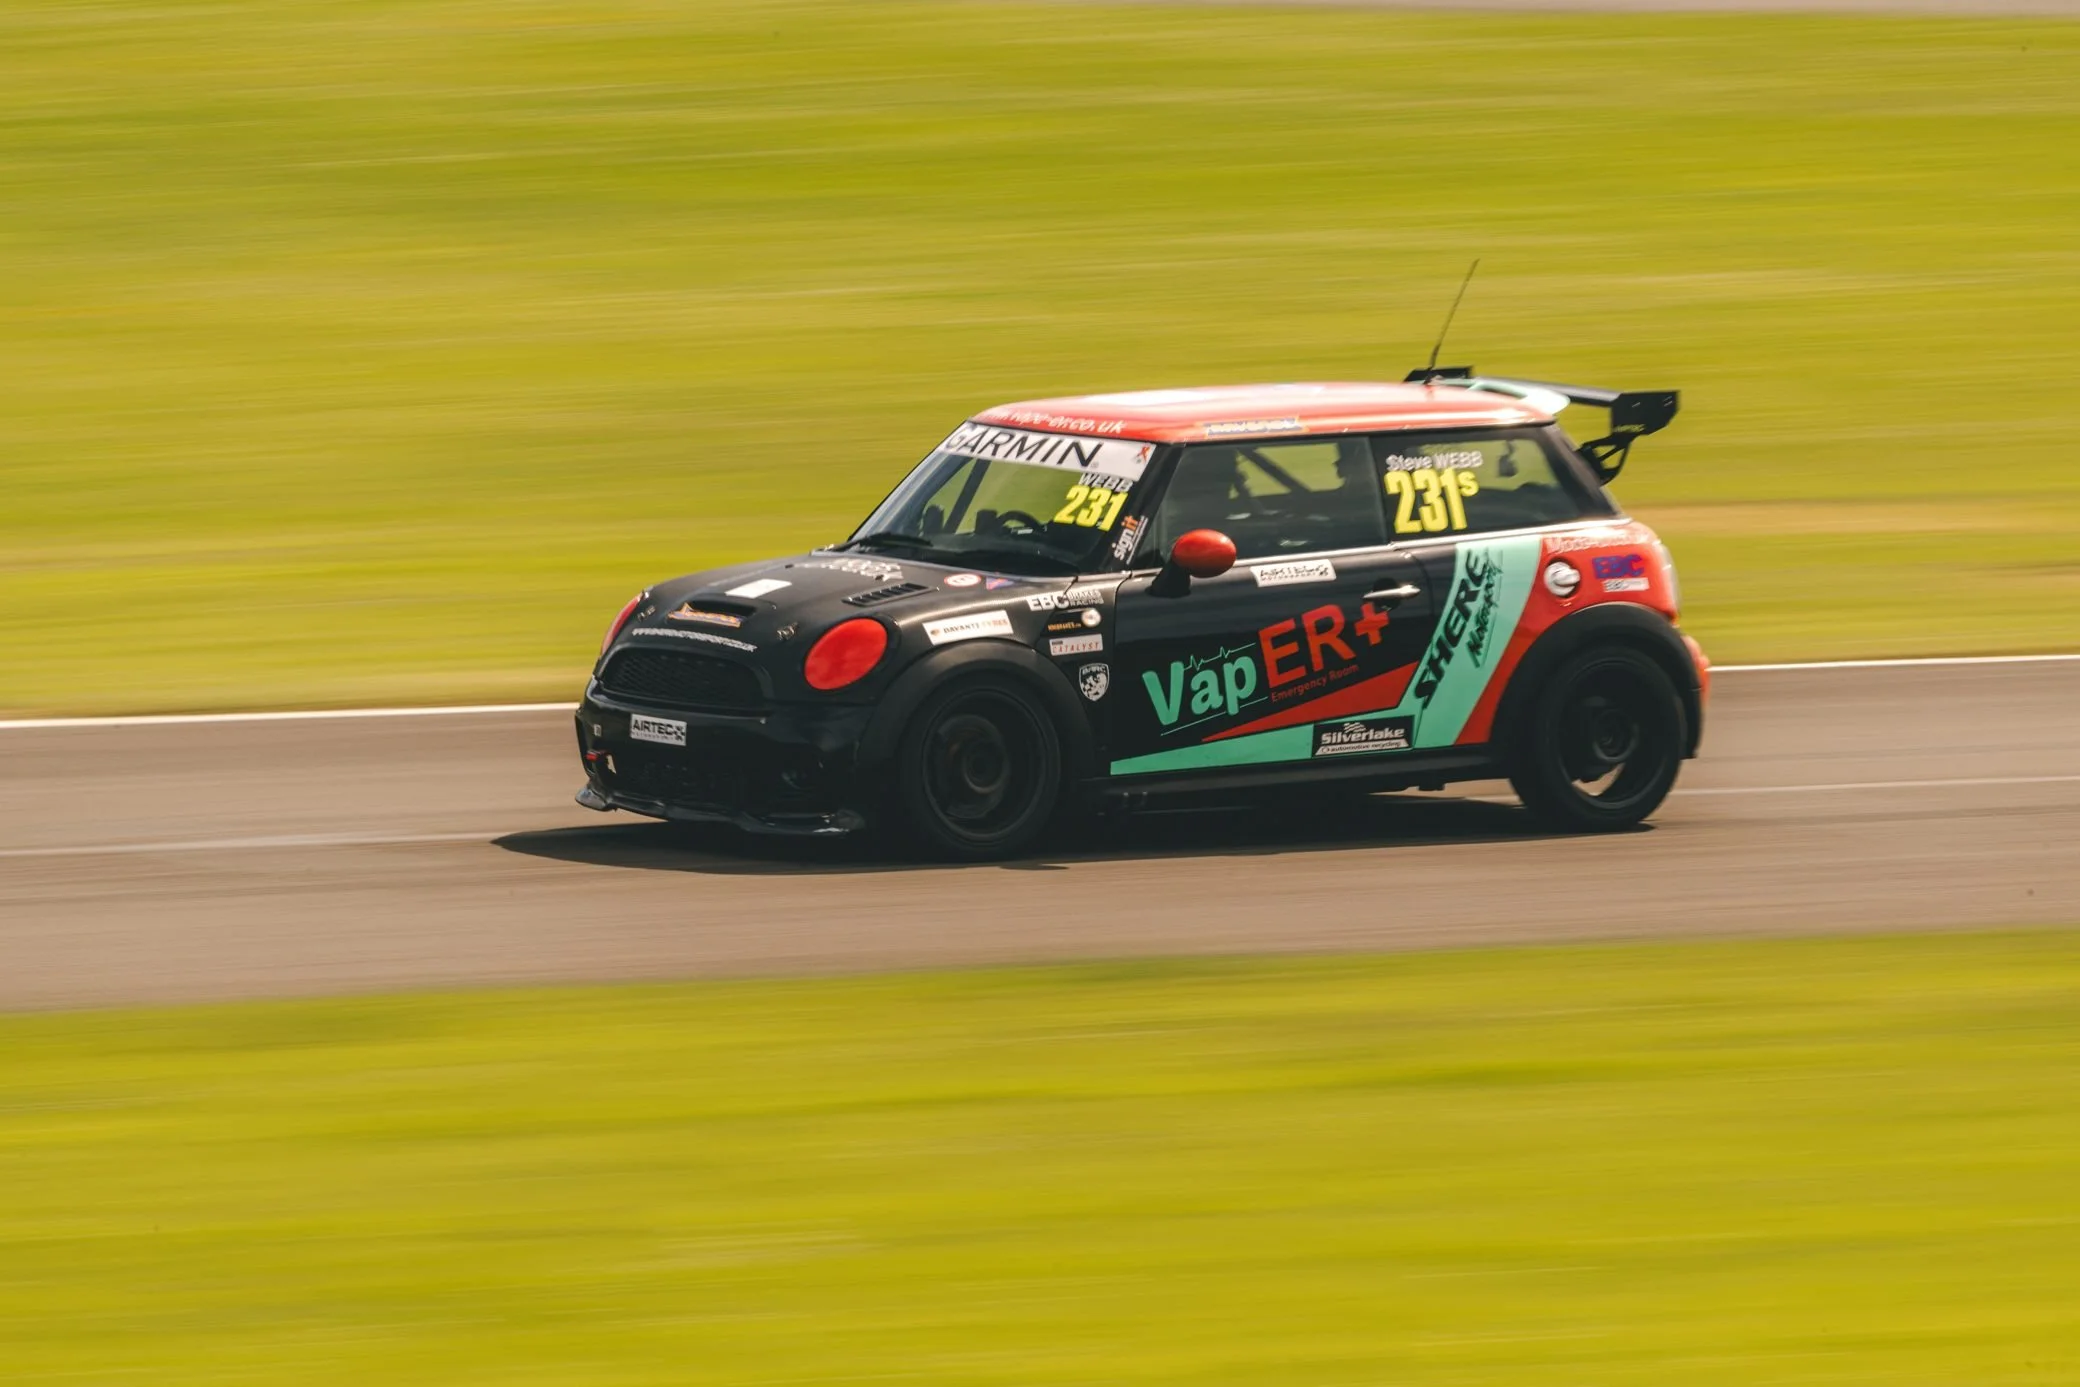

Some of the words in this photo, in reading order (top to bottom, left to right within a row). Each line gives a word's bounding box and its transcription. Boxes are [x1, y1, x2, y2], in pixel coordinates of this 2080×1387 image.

[945, 423, 1103, 467] GARMIN
[1386, 454, 1432, 471] Steve
[1434, 450, 1483, 469] WEBB
[1078, 473, 1133, 492] WEBB
[1053, 485, 1128, 531] 231
[1592, 554, 1644, 579] EBC
[1026, 591, 1069, 611] EBC
[1414, 549, 1489, 710] SHERE
[1271, 675, 1328, 703] Emergency
[1329, 664, 1359, 681] Room
[633, 719, 674, 736] AIRTEC
[1321, 727, 1405, 745] Silverlake
